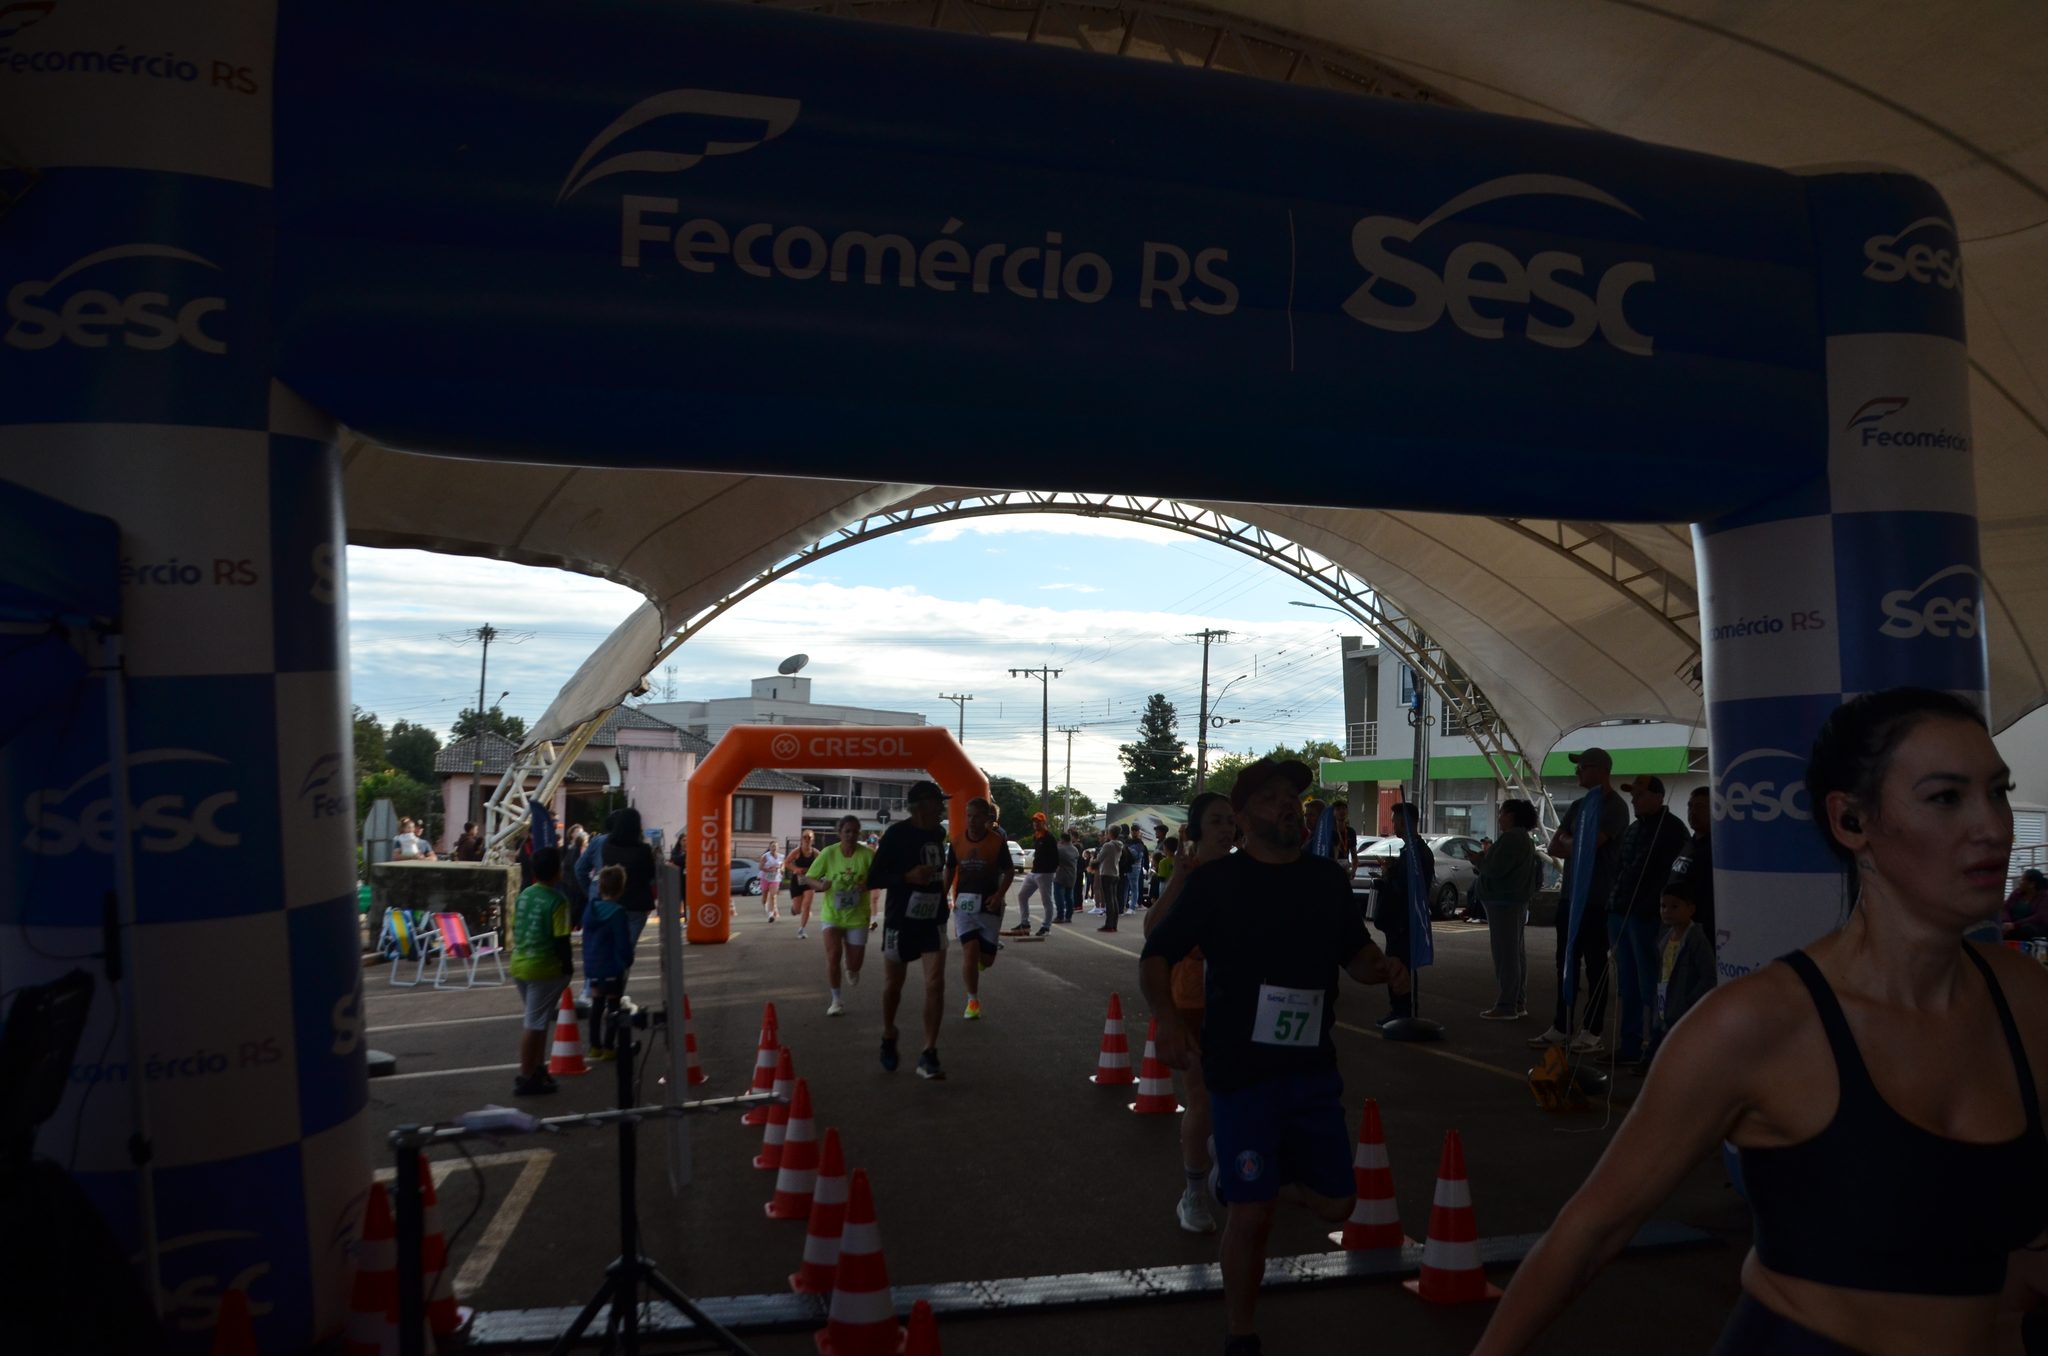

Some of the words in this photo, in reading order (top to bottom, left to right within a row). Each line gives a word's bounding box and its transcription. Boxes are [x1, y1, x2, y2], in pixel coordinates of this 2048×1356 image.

[211, 60, 258, 95] RS
[620, 194, 1113, 304] Fecomércio
[1139, 241, 1239, 316] RS
[1341, 214, 1656, 357] Sesc
[4, 280, 227, 355] Sesc
[119, 557, 201, 587] ércio
[213, 559, 258, 587] RS
[1790, 610, 1826, 633] RS
[809, 736, 913, 758] CRESOL
[701, 808, 719, 897] CRESOL
[1274, 1010, 1310, 1041] 57
[239, 1038, 282, 1069] RS
